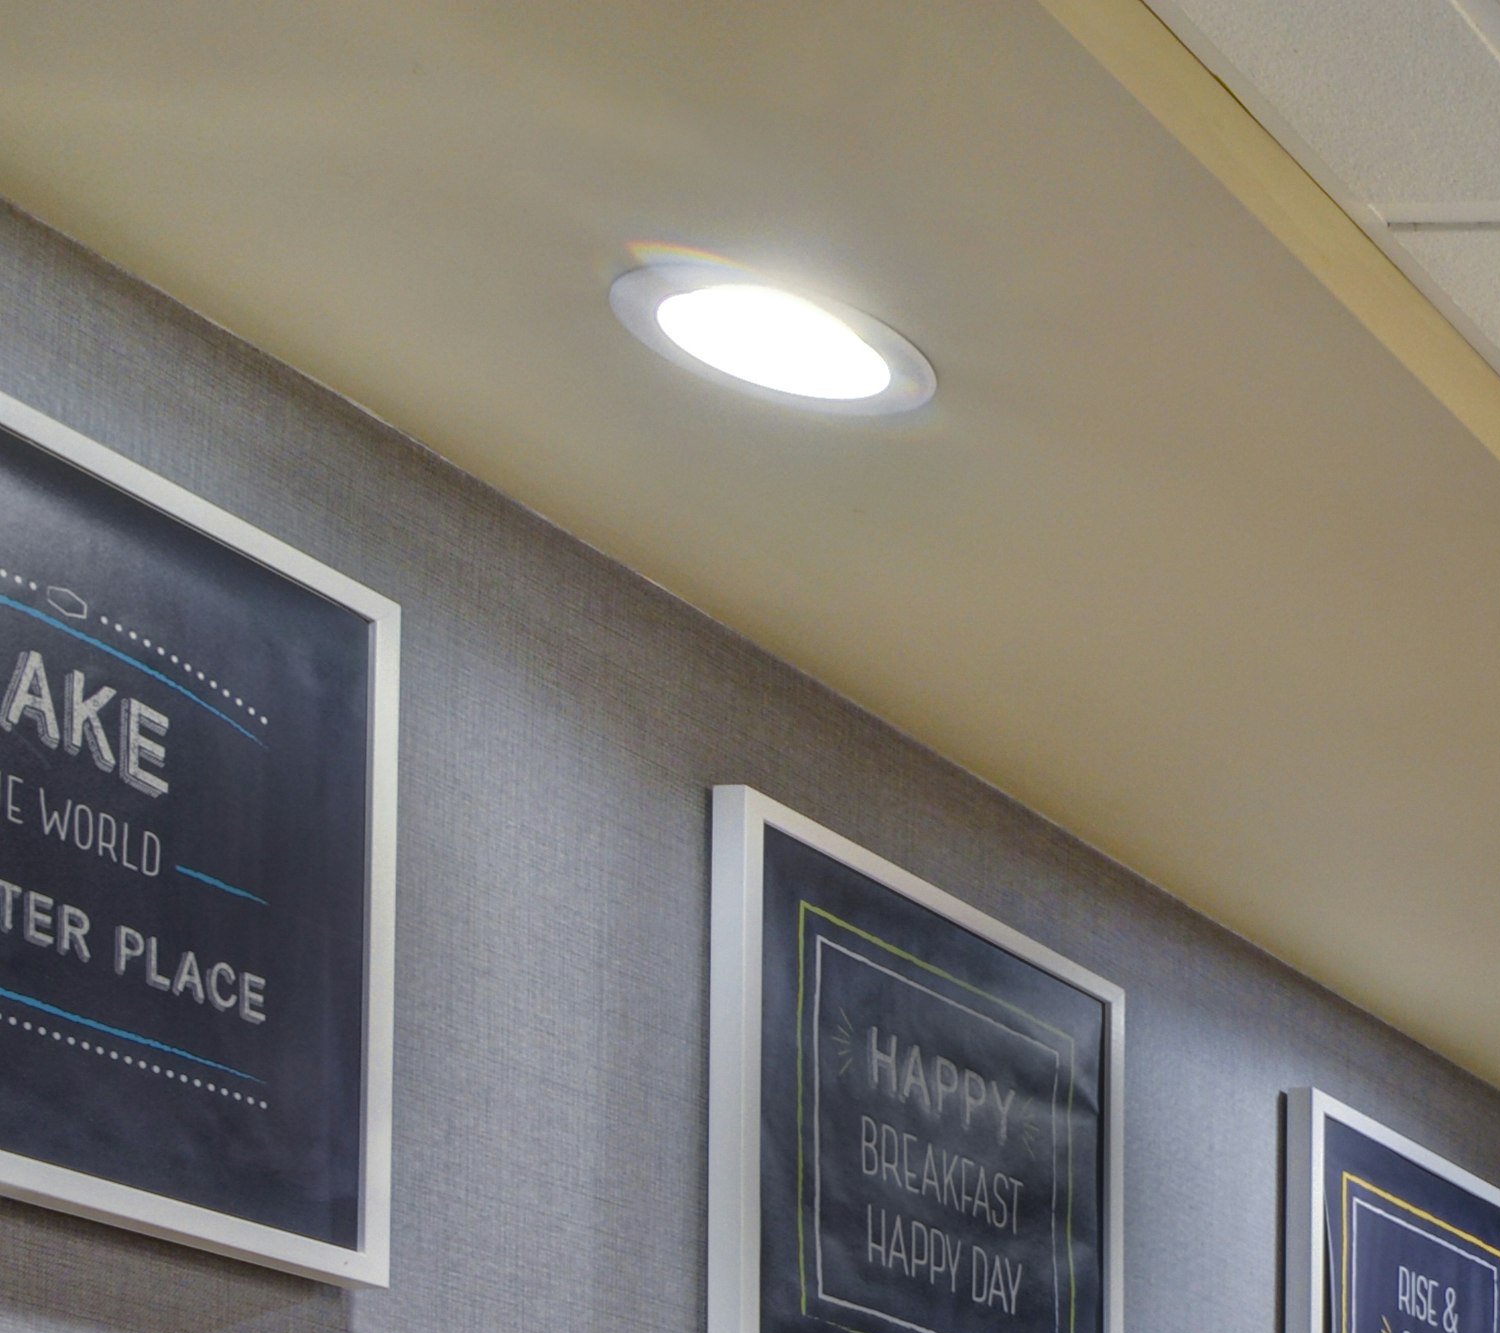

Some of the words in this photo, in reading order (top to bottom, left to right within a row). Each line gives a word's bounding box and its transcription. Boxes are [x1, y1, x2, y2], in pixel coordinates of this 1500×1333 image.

[0, 650, 169, 798] AKE
[39, 787, 160, 877] WORLD
[0, 879, 91, 963] TER
[114, 924, 267, 1025] PLACE
[867, 1026, 1015, 1146] HAPPY
[861, 1115, 1024, 1235] BREAKFAST
[867, 1203, 961, 1293] HAPPY
[972, 1245, 1022, 1315] DAY
[1398, 1265, 1439, 1327] RISE
